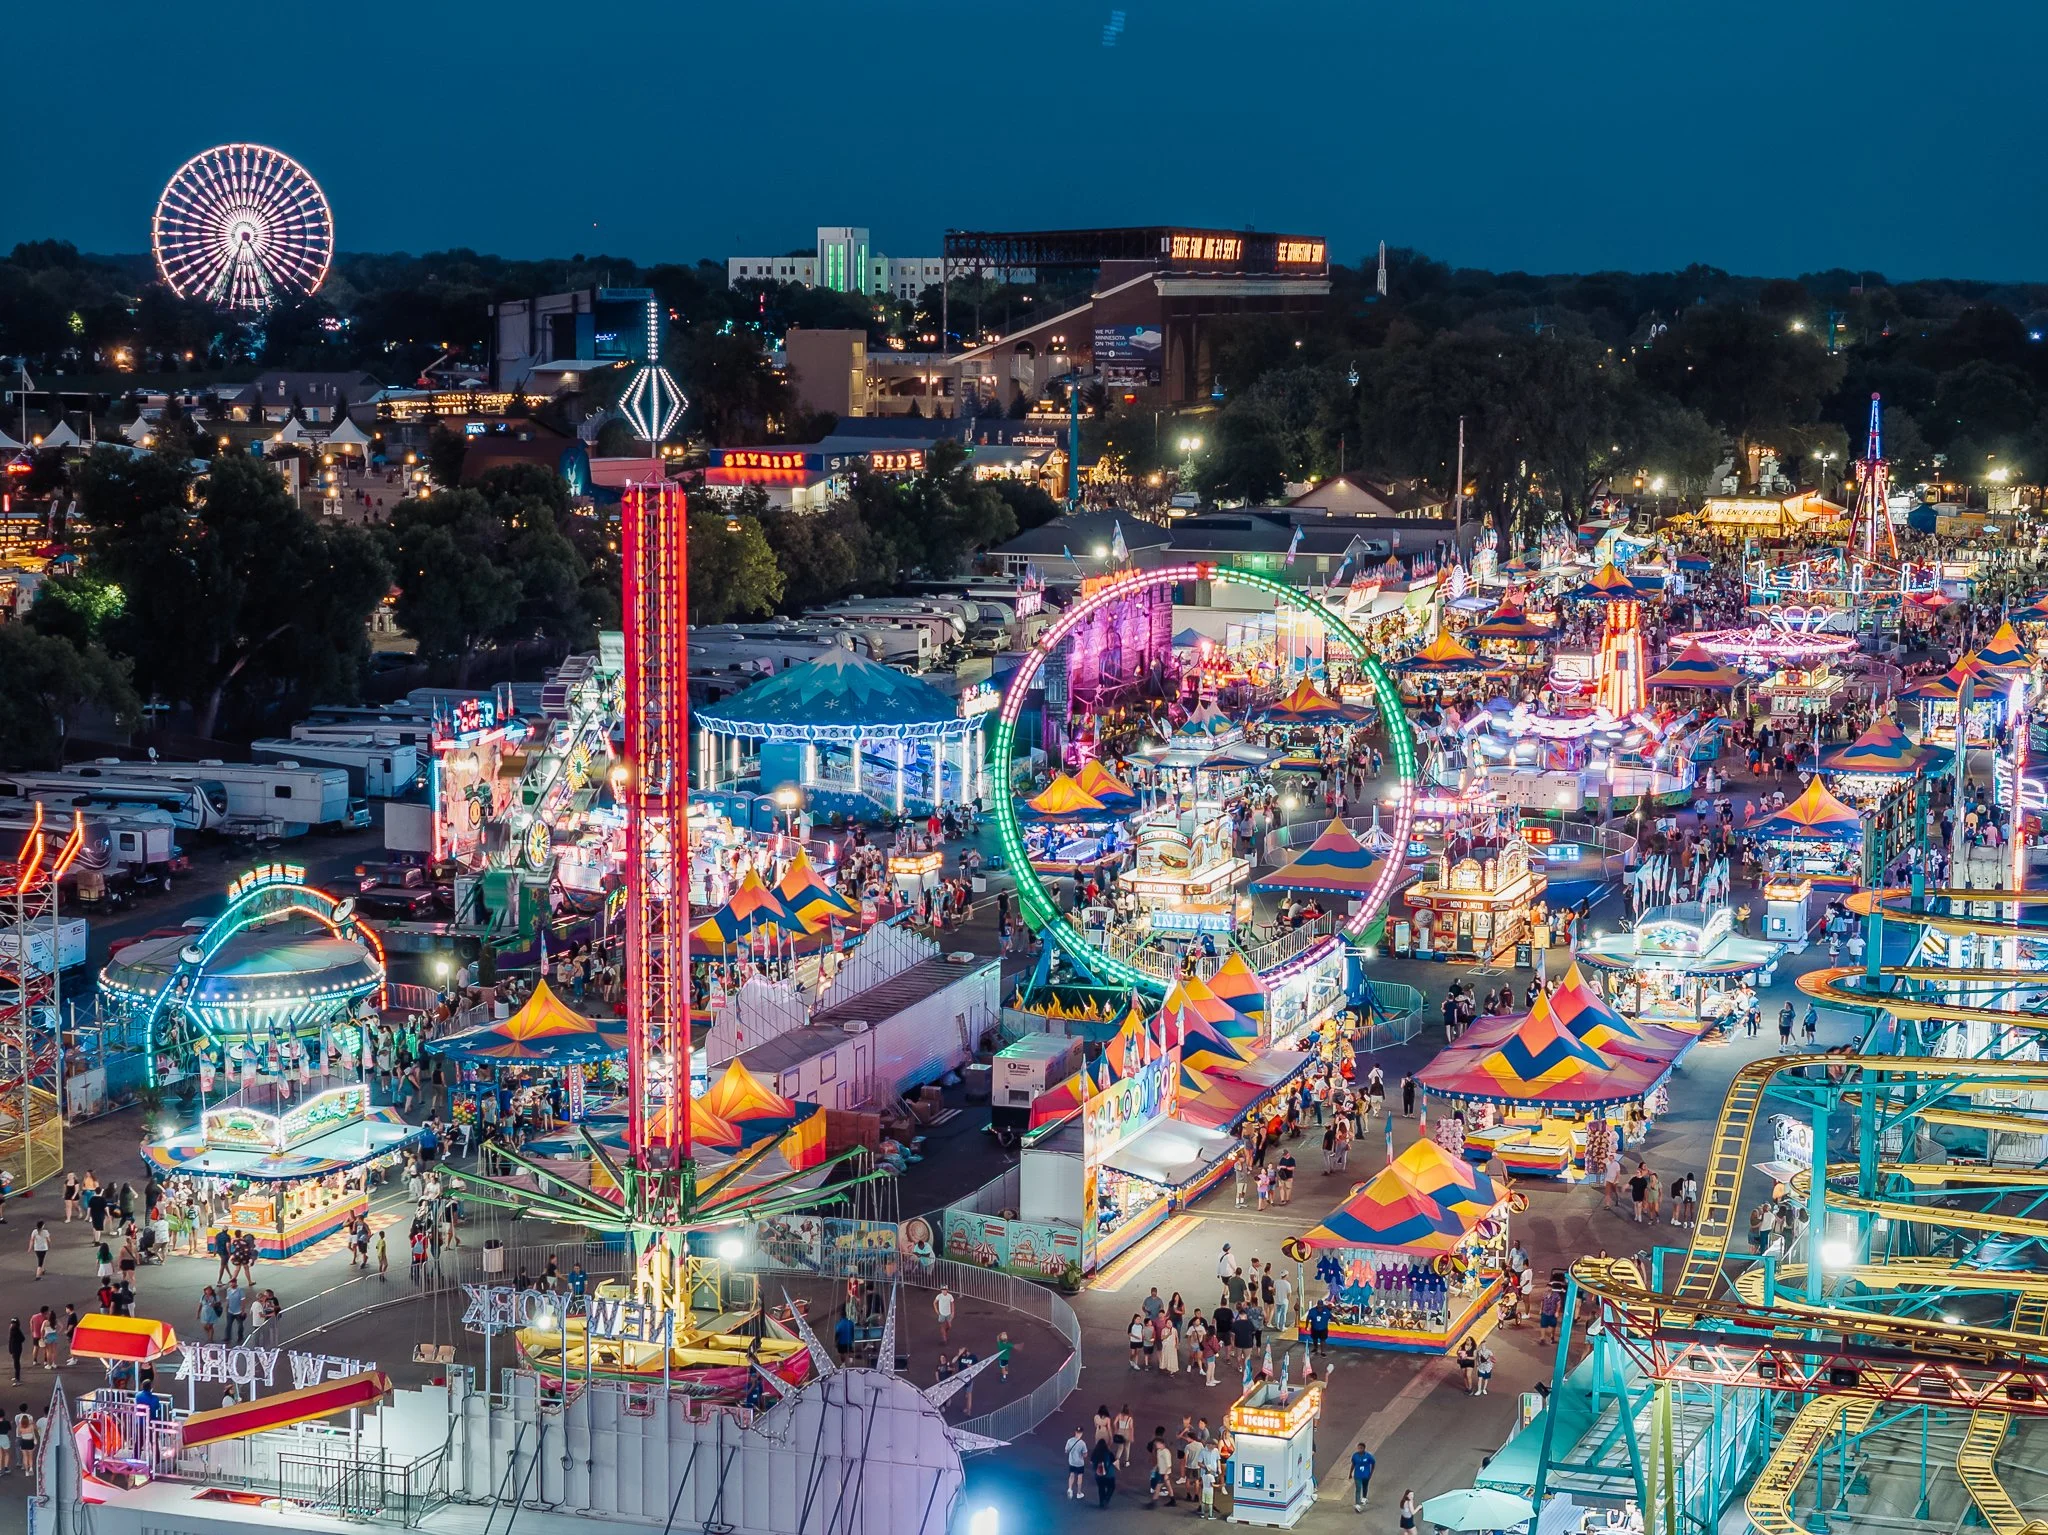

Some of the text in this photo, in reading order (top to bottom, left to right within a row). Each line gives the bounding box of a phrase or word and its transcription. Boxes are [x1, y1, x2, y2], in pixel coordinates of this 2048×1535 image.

[724, 453, 804, 469] SKYRIDE
[1716, 508, 1778, 517] FRENCH FRIES
[1140, 830, 1189, 845] FRENCH FRIES
[1135, 884, 1152, 892] JUMBO
[1152, 884, 1167, 893] CORN
[1463, 901, 1484, 910] DNUTS
[1154, 913, 1231, 931] INFINITY
[1154, 1061, 1177, 1105] POP
[1243, 1414, 1280, 1429] TICKETS
